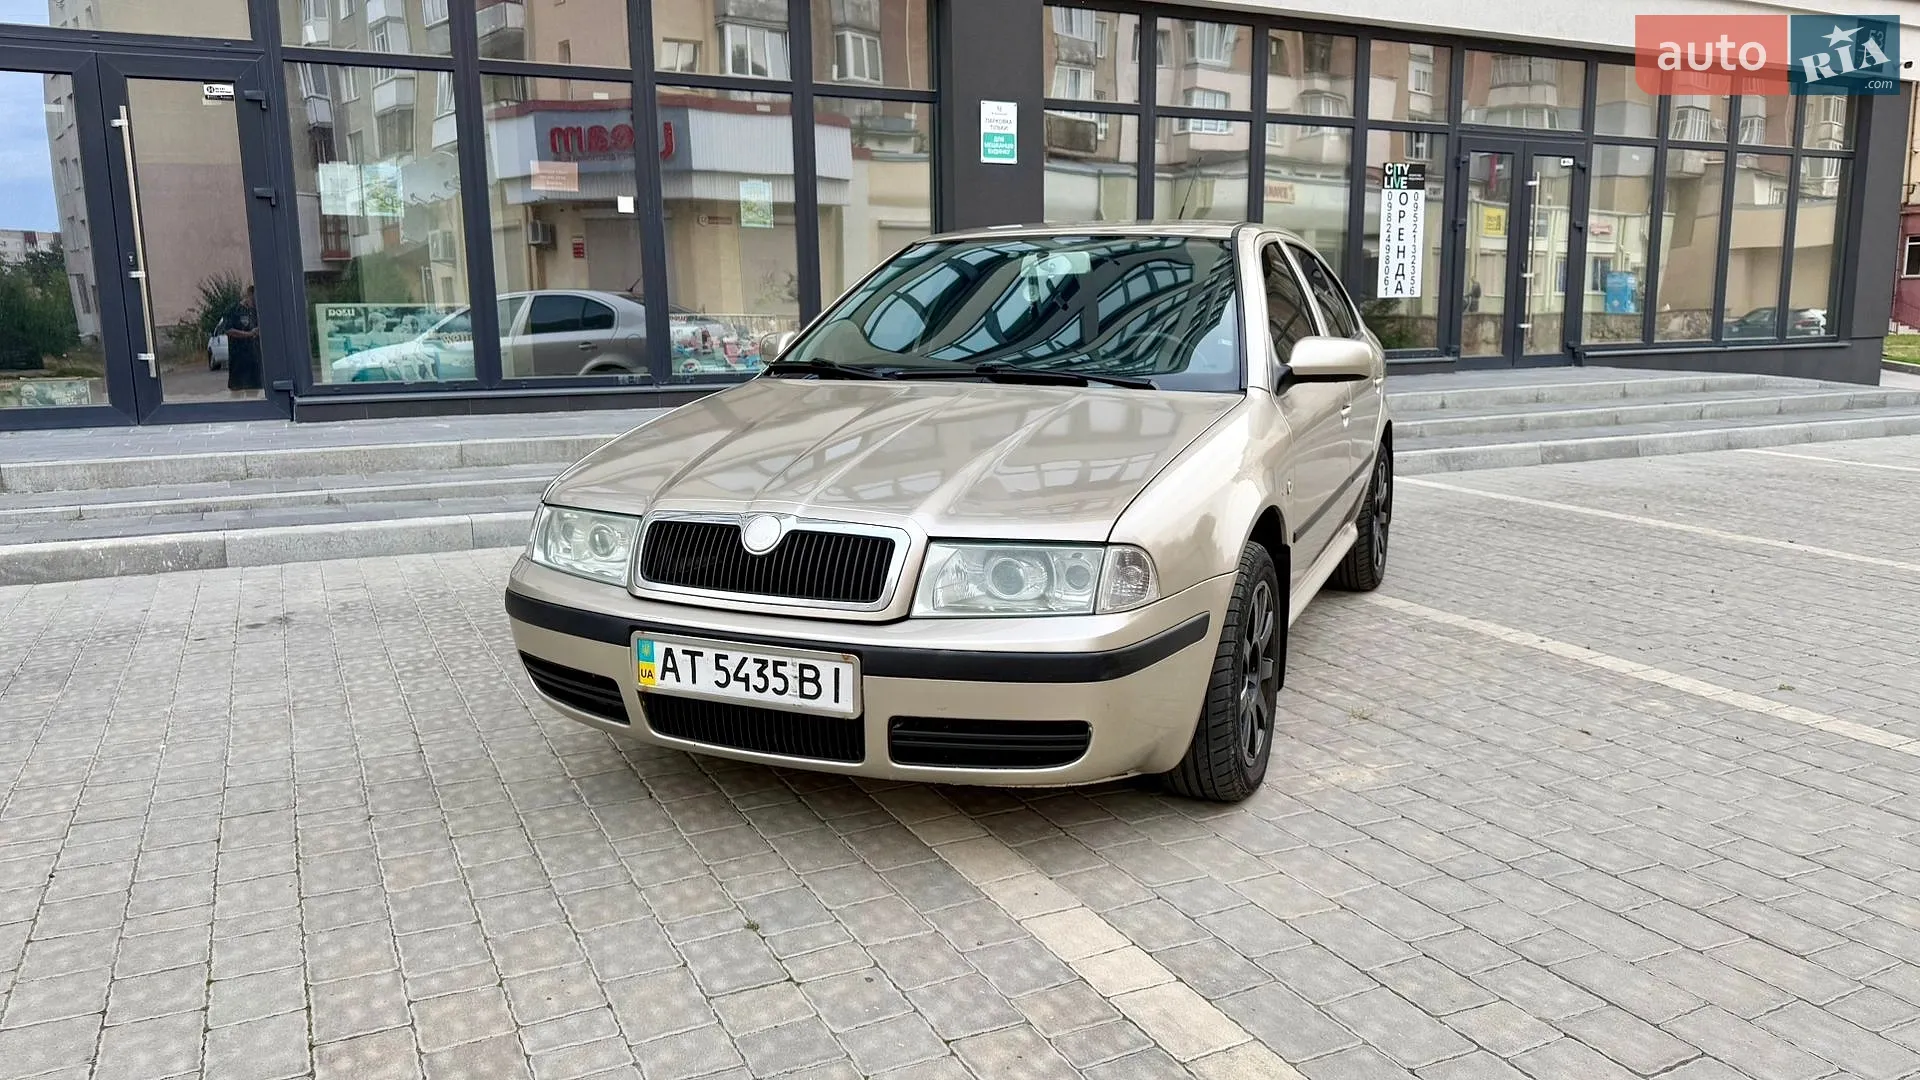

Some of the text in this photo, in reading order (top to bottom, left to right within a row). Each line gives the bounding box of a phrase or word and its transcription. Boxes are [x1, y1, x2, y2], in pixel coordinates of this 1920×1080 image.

[1385, 163, 1410, 176] CITY
[1384, 176, 1408, 189] LIVE
[1394, 192, 1409, 295] ОРЕНДА
[640, 668, 654, 680] UA
[660, 647, 704, 685] AT
[714, 653, 789, 696] 5435
